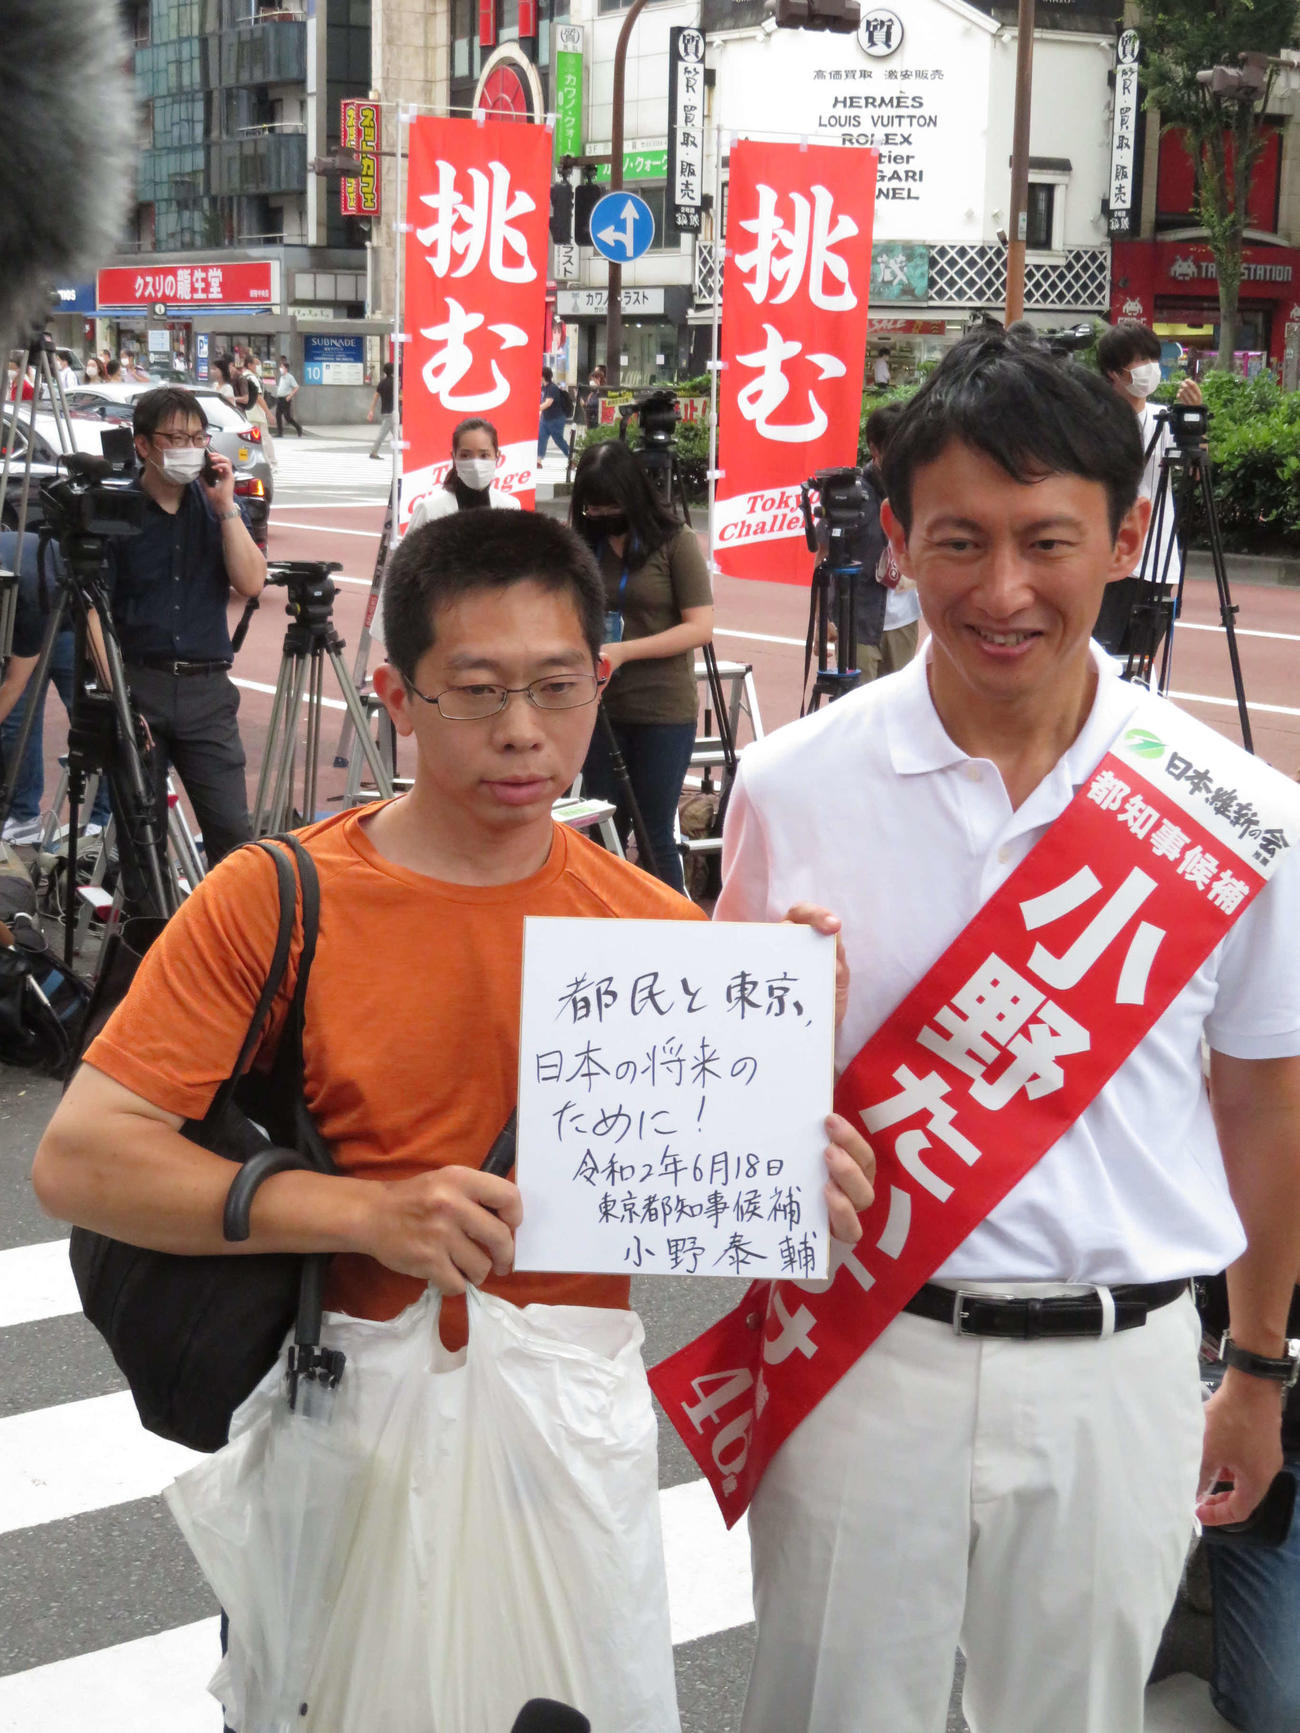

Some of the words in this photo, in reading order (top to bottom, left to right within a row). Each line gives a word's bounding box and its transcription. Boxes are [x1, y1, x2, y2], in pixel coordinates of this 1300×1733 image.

[813, 70, 873, 81] 高価買取
[884, 70, 944, 81] 激安販売
[818, 115, 861, 128] LOUIS
[871, 115, 938, 128] VUITTON
[877, 153, 916, 165] tier
[135, 268, 222, 299] クスリの龍生堂
[416, 160, 537, 412] 挑む
[734, 184, 859, 443] 挑む
[307, 367, 320, 380] 10
[1165, 752, 1290, 858] 日本維新の会
[1086, 770, 1250, 916] 都知事候補
[535, 1036, 757, 1092] 日本の将来の
[572, 1145, 783, 1187] 令和2年6月18日
[598, 1186, 801, 1231] 東京都知事候補
[624, 1231, 817, 1279] 小野泰輔
